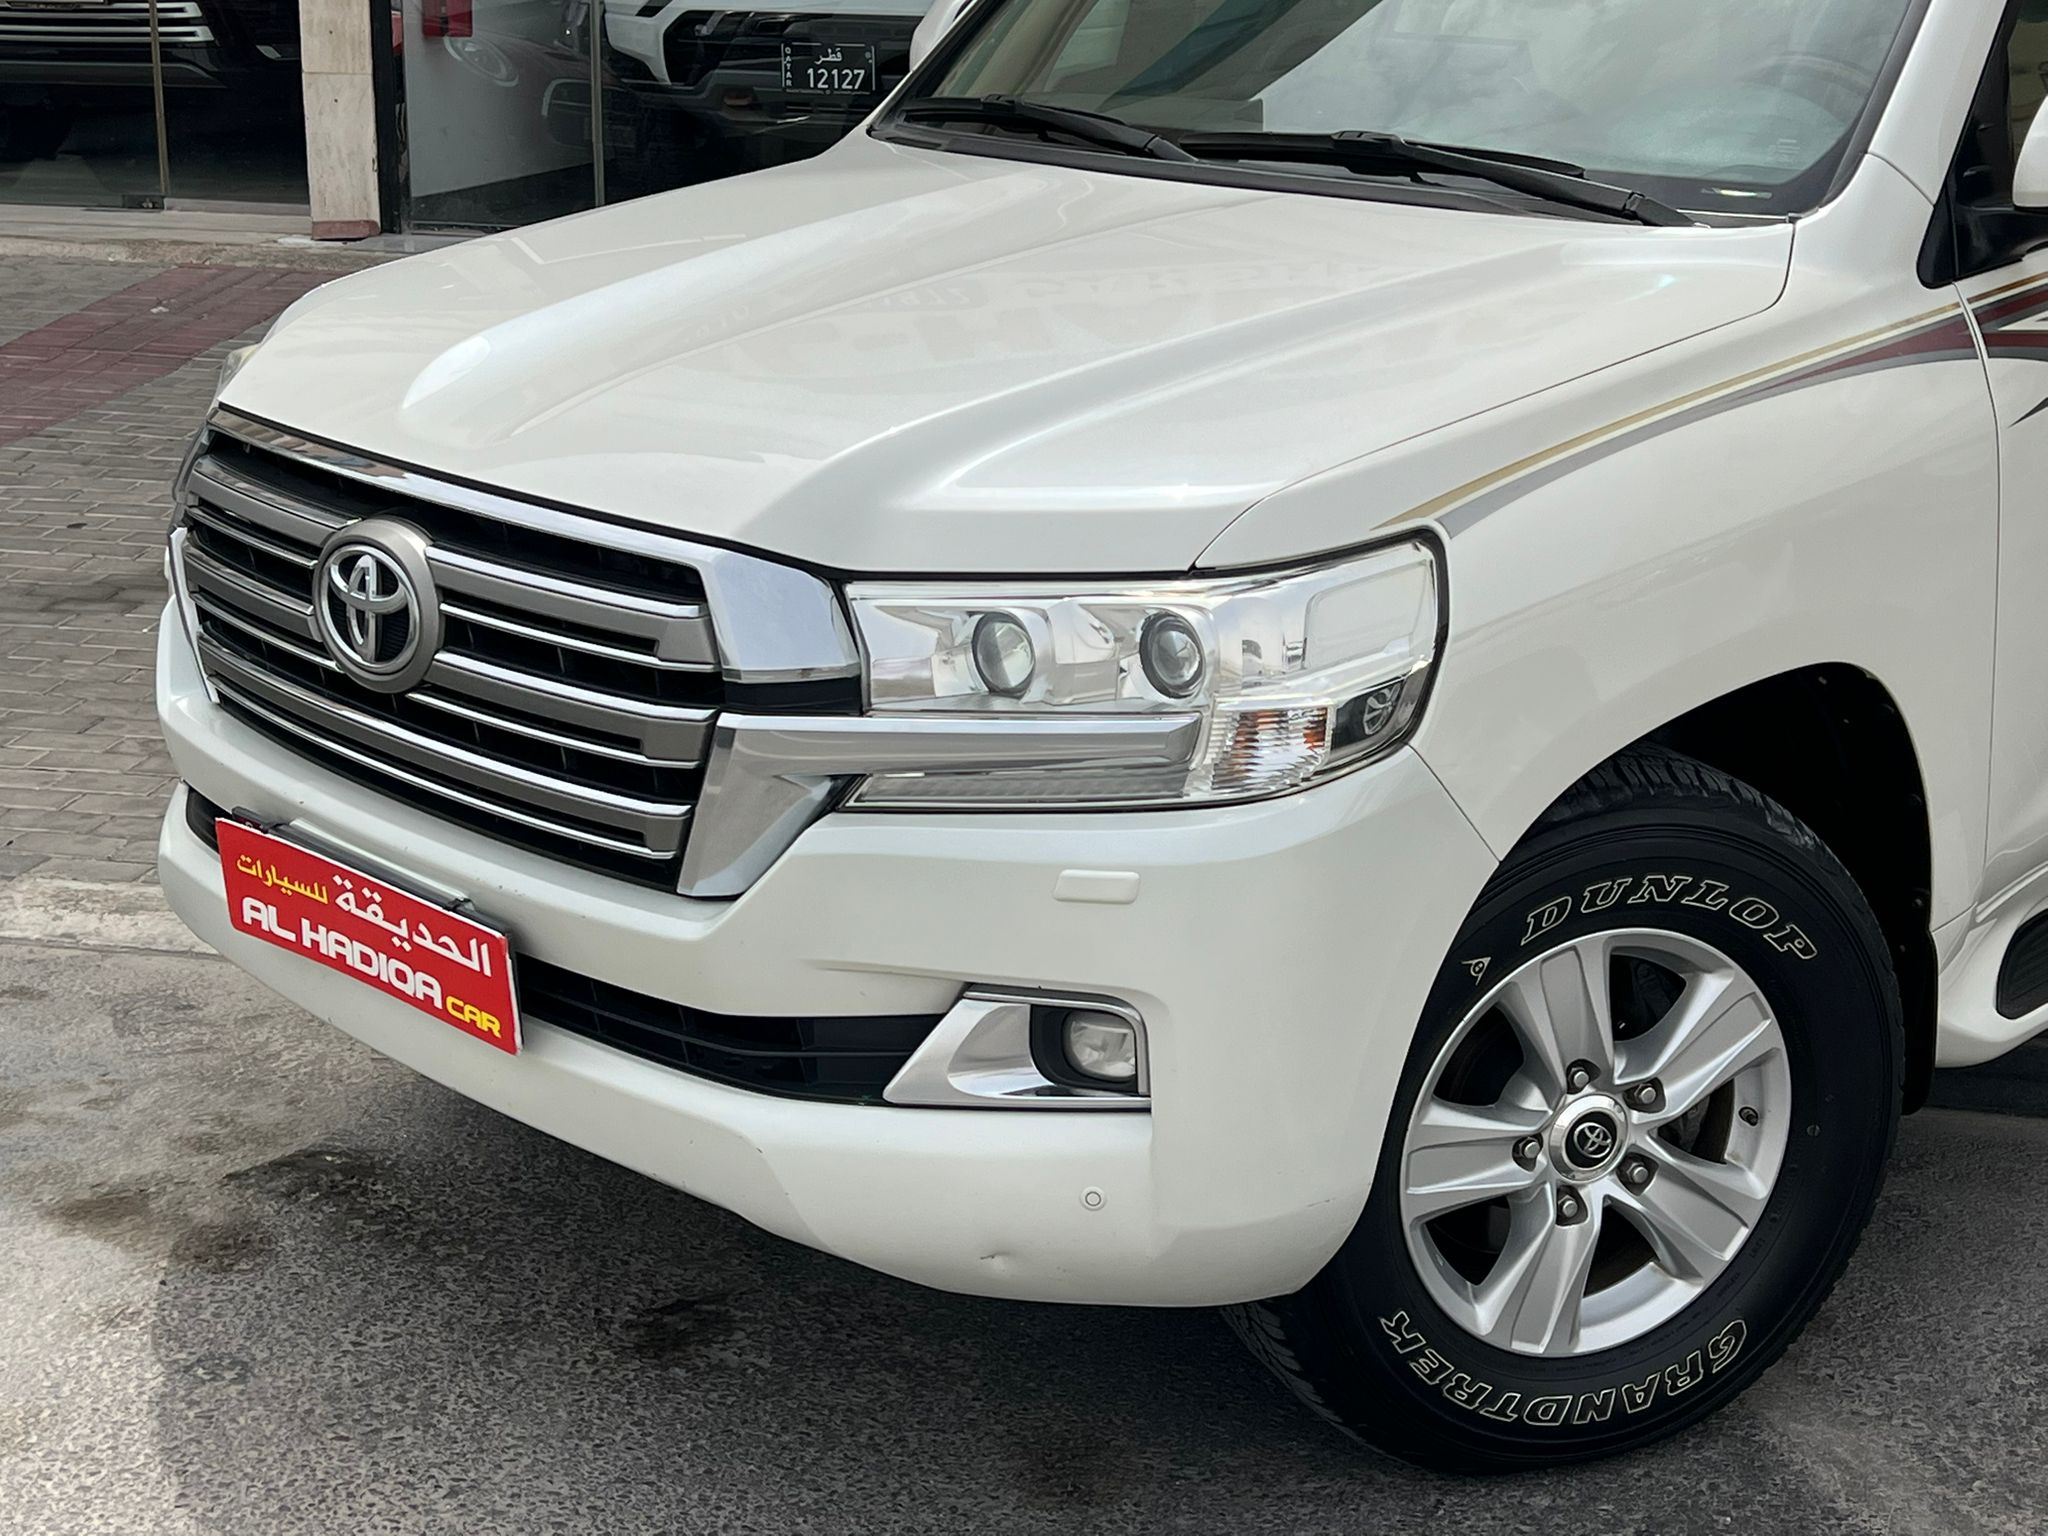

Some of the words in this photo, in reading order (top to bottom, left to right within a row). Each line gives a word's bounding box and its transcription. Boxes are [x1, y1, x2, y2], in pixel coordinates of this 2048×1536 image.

[784, 47, 793, 87] QATAR
[807, 68, 865, 89] 12127
[814, 47, 842, 65] قطر
[236, 854, 328, 904] للسيارات
[332, 875, 492, 977] الحديقة
[1520, 874, 1818, 962] DUNLOP
[242, 897, 296, 942] AL
[302, 918, 442, 1009] HADIQA
[446, 996, 502, 1037] CAR
[1379, 1309, 1748, 1426] GRANDTREK
